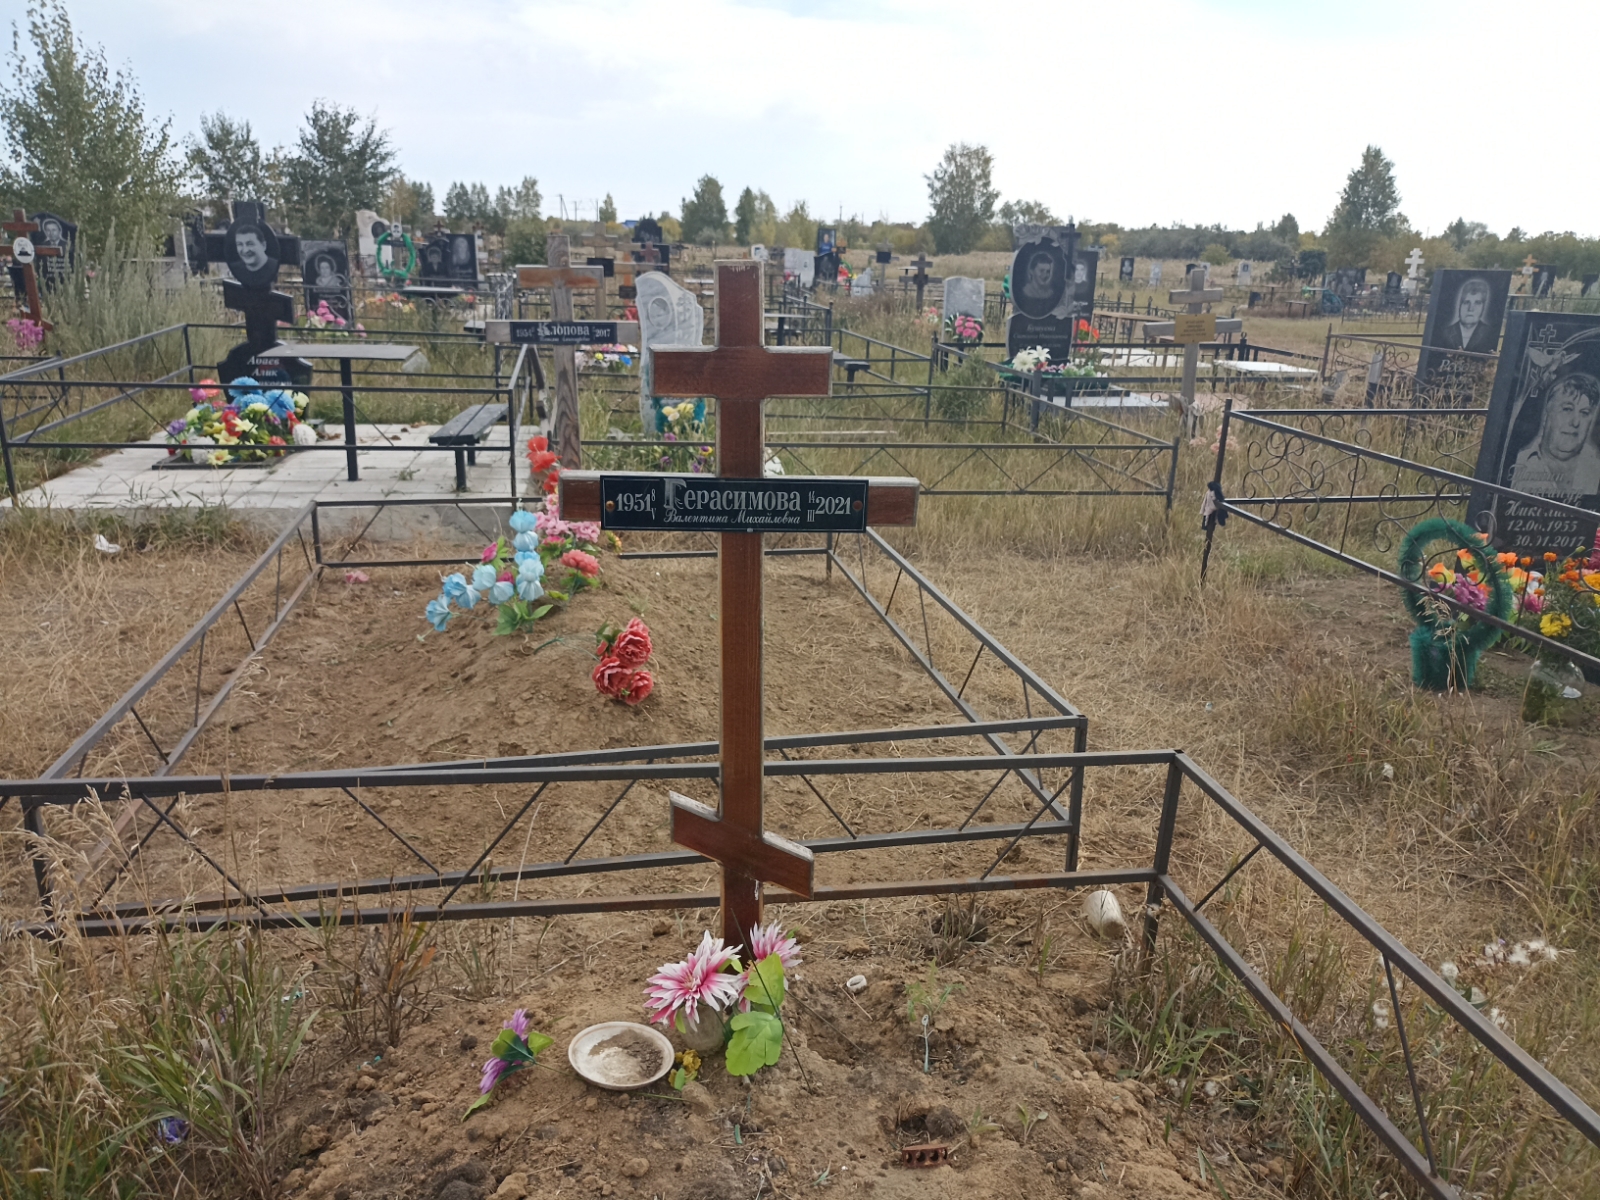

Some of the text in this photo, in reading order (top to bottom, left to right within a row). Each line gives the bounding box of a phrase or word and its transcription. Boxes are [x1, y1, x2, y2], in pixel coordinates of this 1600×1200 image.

[595, 328, 611, 338] 2017
[616, 478, 851, 515] 1951 Герасимова 2021
[663, 508, 800, 524] Валентина Михайловна
